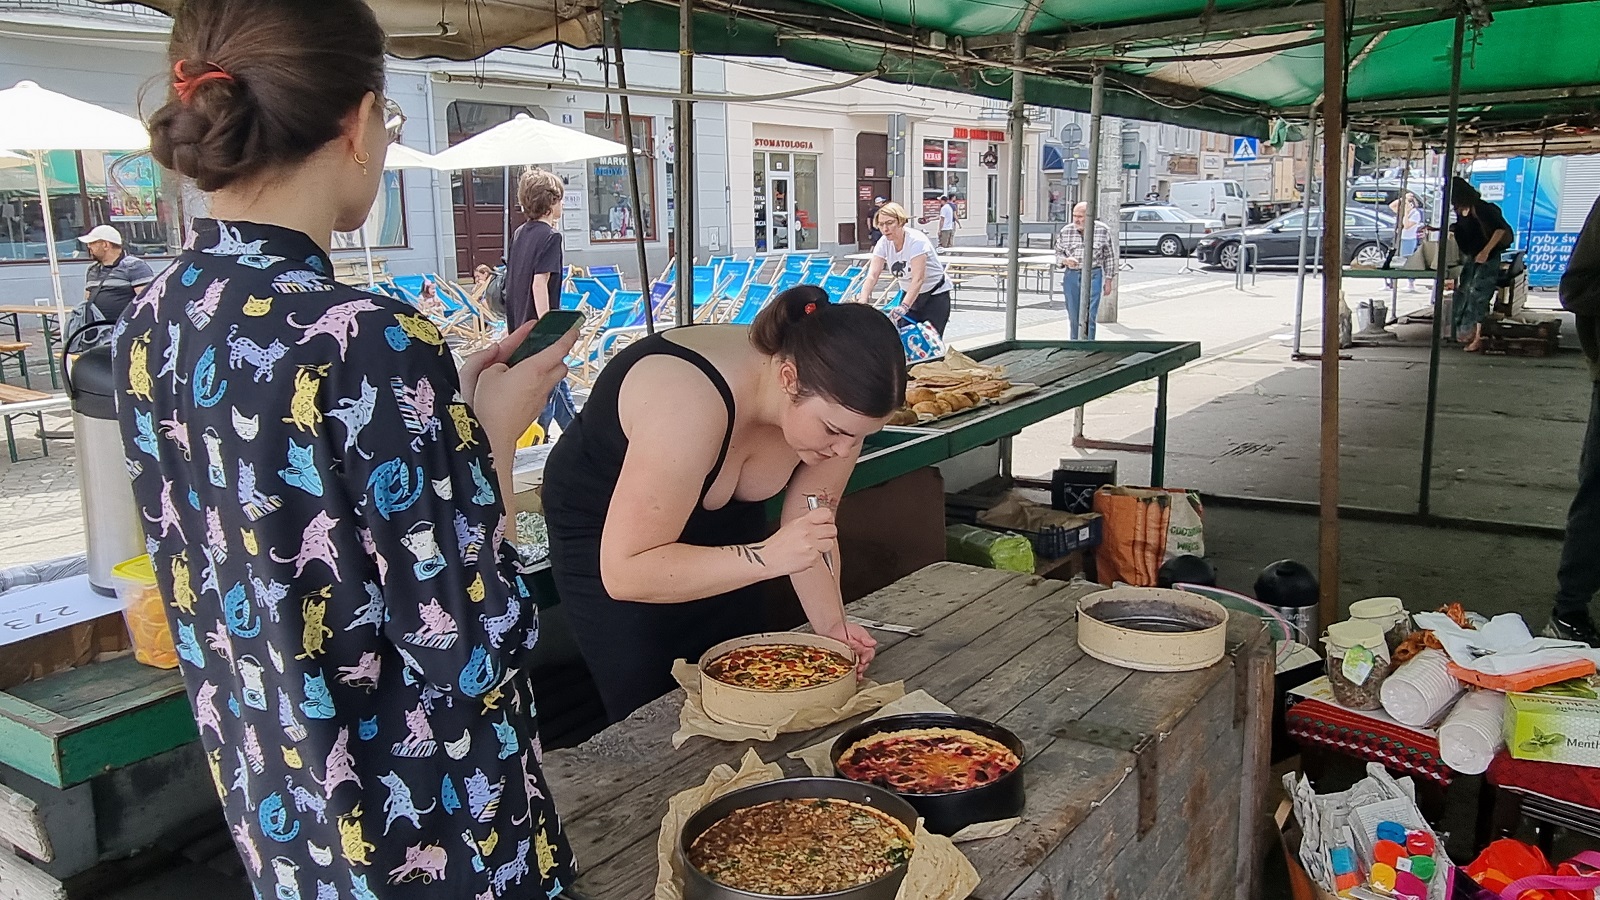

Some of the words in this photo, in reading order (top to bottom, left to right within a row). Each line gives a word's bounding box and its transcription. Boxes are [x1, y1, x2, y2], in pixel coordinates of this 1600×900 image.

[754, 138, 813, 149] STOMATOLOGIA
[599, 157, 629, 166] MARK
[1532, 234, 1558, 243] ryby
[1531, 244, 1557, 253] ryby
[1530, 253, 1557, 263] ryby
[1529, 262, 1556, 272] ryby
[3, 606, 79, 630] 273
